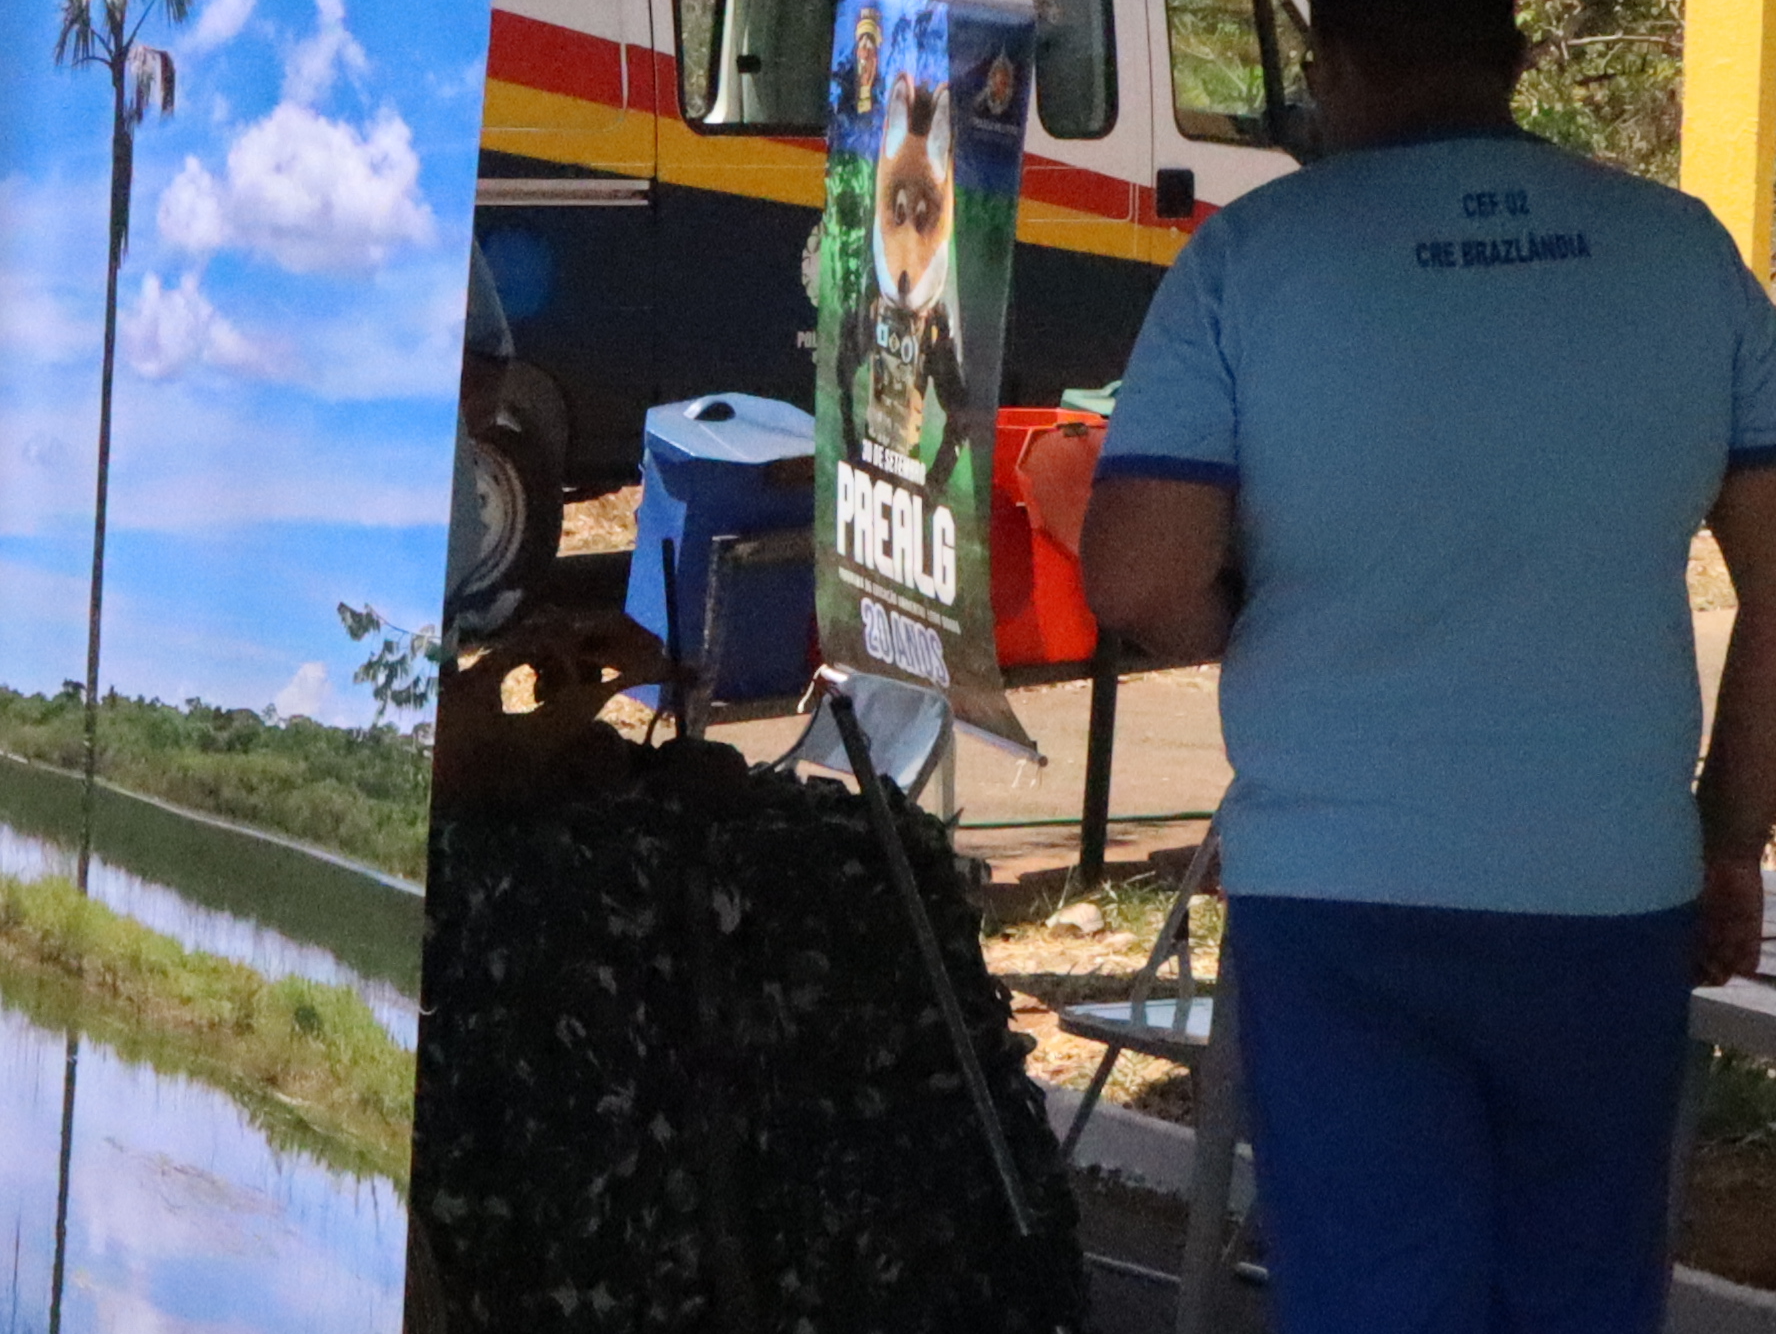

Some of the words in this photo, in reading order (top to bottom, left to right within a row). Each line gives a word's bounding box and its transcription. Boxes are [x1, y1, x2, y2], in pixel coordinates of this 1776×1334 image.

[1462, 191, 1499, 218] CEF
[1415, 241, 1457, 268] CRE
[836, 460, 957, 607] PREALG
[860, 596, 894, 665] 20
[889, 610, 950, 688] ANOS
